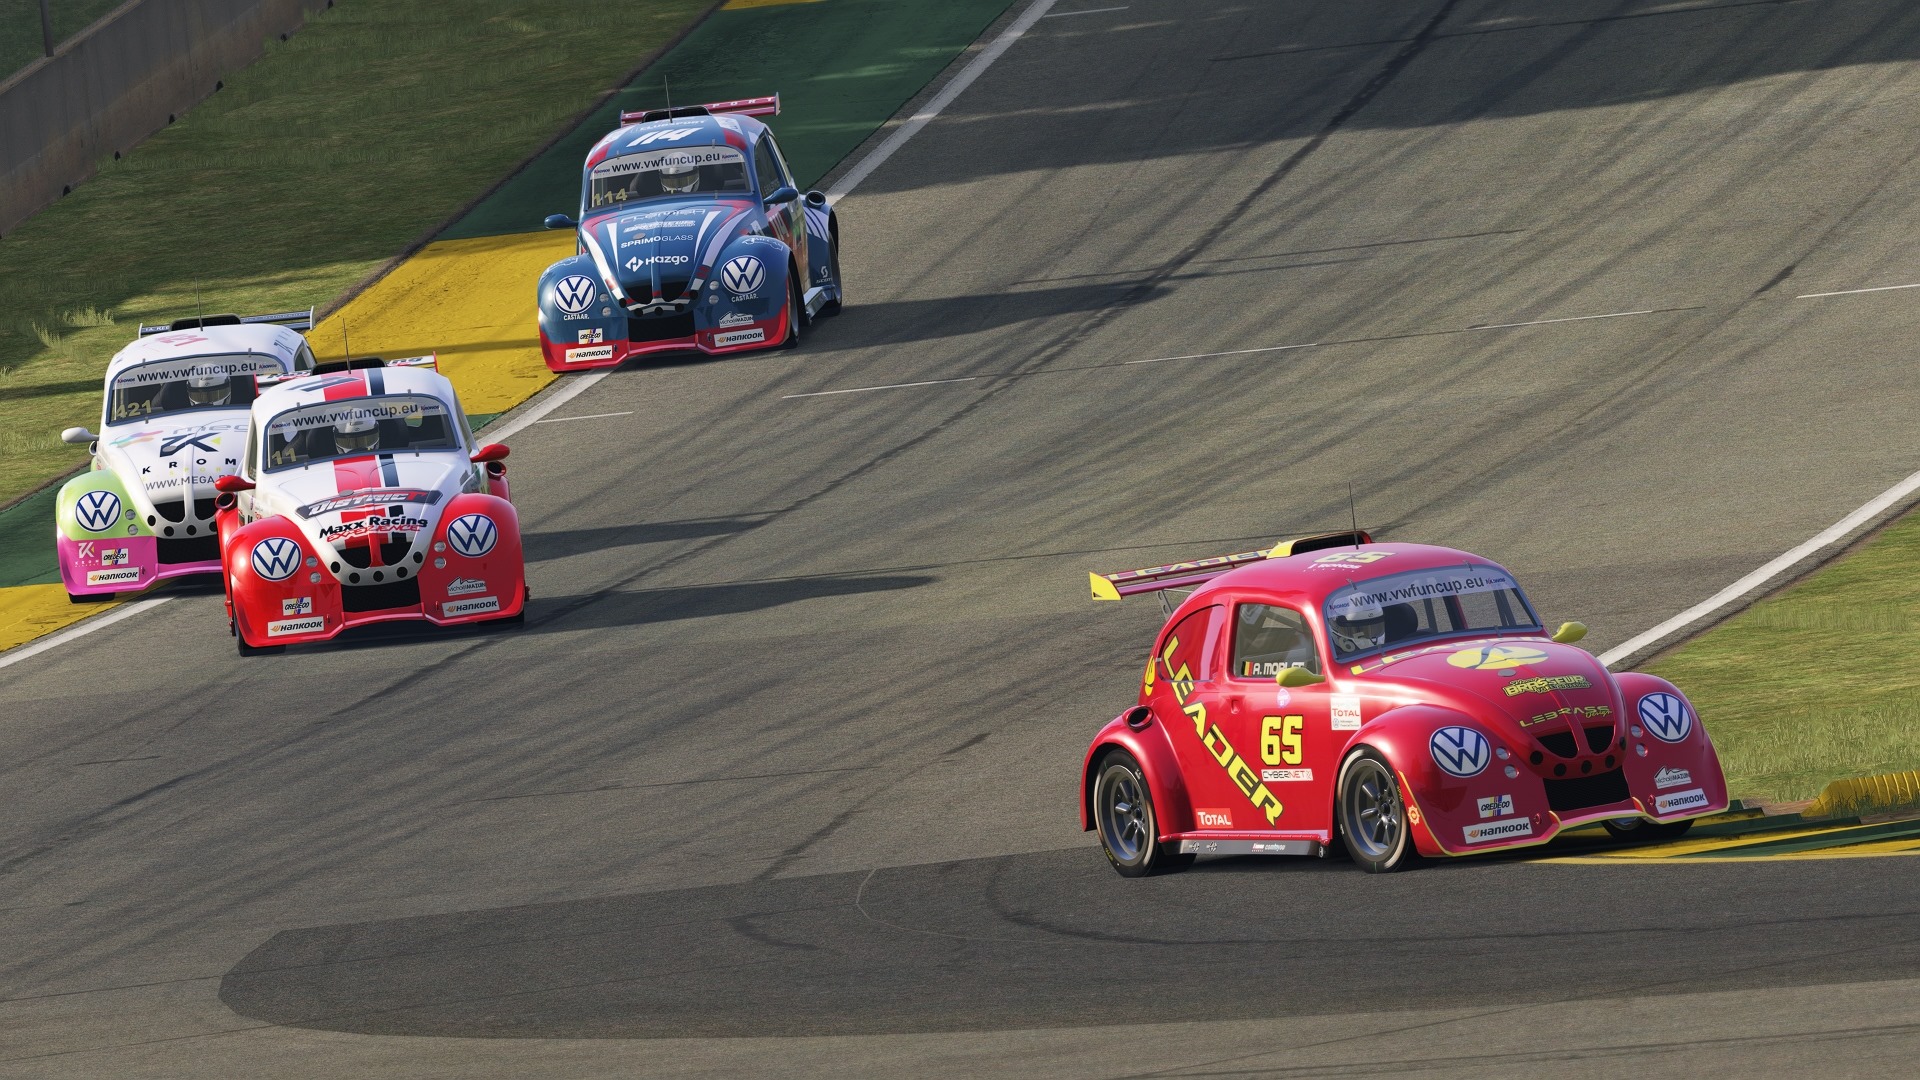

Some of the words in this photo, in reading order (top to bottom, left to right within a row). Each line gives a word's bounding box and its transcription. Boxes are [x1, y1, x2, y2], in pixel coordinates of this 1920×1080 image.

[625, 127, 705, 148] 114
[611, 153, 720, 173] www.vwfuncup.eu
[592, 187, 628, 206] 114
[620, 234, 694, 249] SPRIMOGLASS
[645, 255, 689, 266] Hazgo
[137, 361, 257, 383] www.vwfuncup.eu
[116, 399, 152, 419] 421
[292, 404, 419, 427] www.vwfuncup.eu
[271, 448, 297, 465] 11
[319, 520, 364, 539] Maxx
[369, 516, 428, 528] Racing
[1313, 551, 1397, 564] 65
[1350, 577, 1485, 608] www.vwfuncup.eu
[1163, 635, 1284, 828] LEADER
[1260, 714, 1304, 766] 65
[1481, 801, 1510, 811] CREDECO
[1198, 811, 1232, 826] TOTAL
